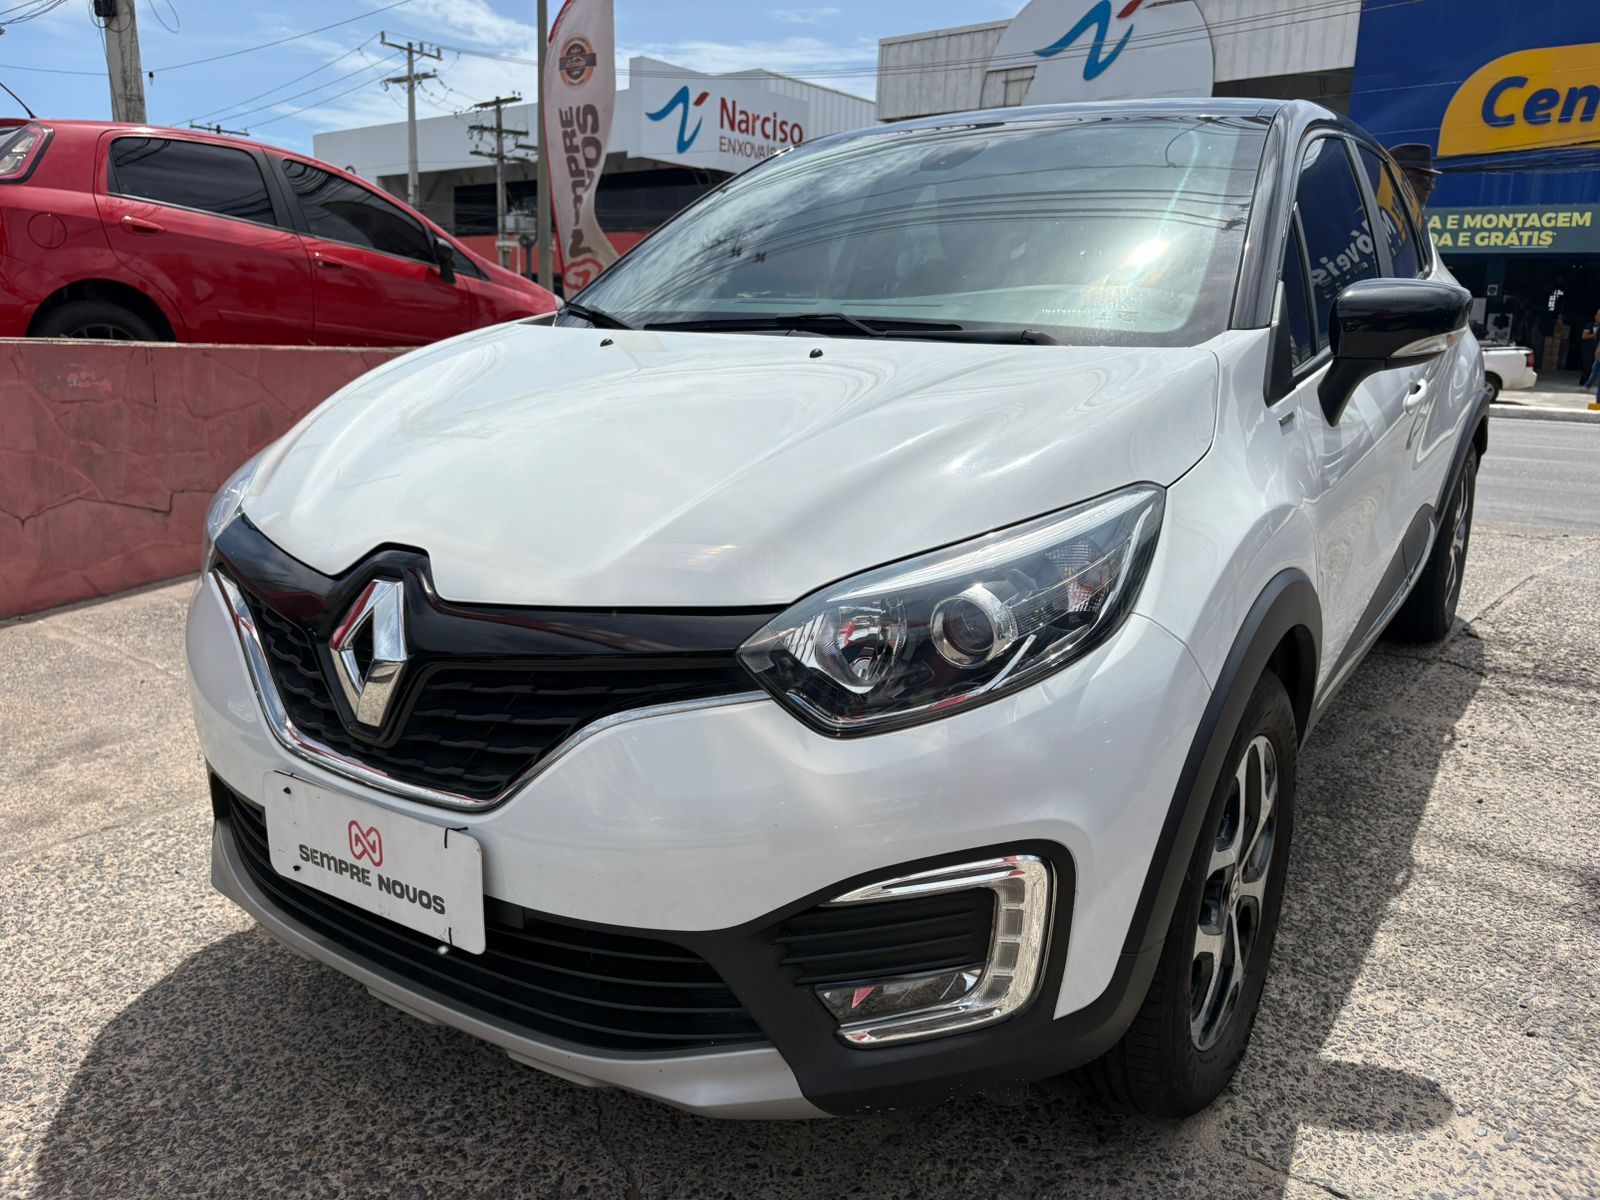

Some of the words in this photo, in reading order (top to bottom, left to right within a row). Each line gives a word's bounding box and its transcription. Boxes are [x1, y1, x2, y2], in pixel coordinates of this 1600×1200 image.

[720, 97, 803, 145] Narciso
[1482, 76, 1600, 127] Cen
[1446, 215, 1460, 229] E
[1463, 212, 1592, 229] MONTAGEM
[1457, 232, 1471, 247] E
[299, 844, 372, 887] SEMPRE
